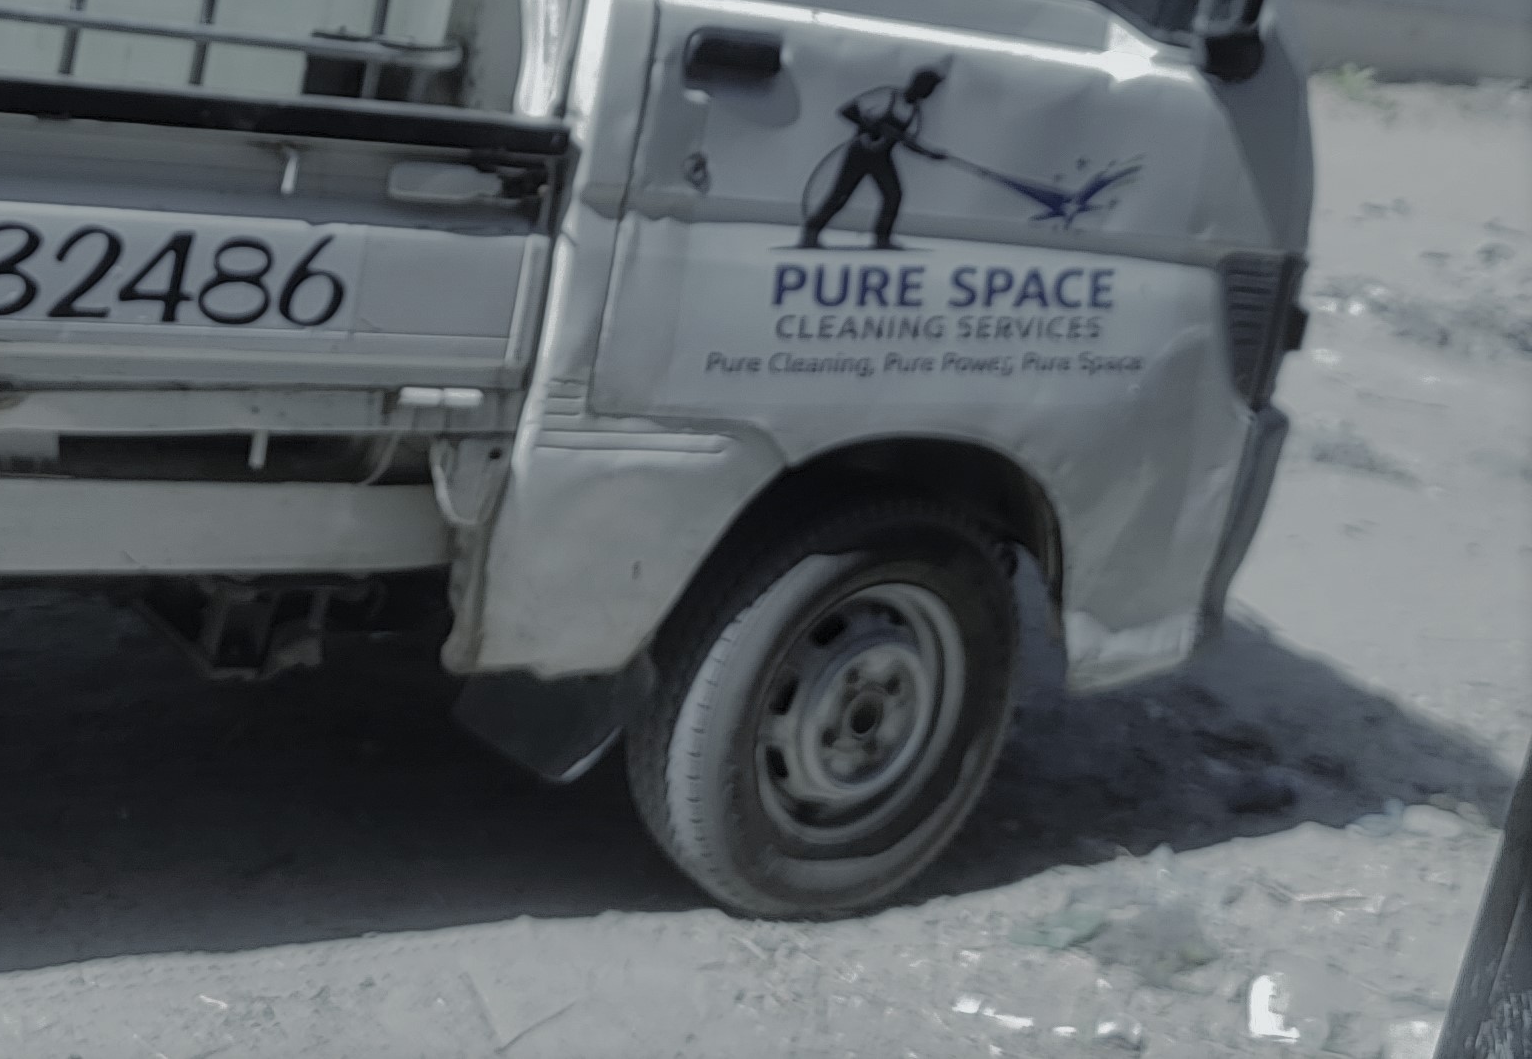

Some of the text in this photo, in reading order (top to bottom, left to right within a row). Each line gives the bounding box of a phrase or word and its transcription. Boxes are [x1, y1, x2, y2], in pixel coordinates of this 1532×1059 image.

[772, 263, 1115, 309] PURE SPACE
[775, 313, 1103, 342] CLEANING SERVICES
[704, 350, 763, 374] Pure
[768, 350, 875, 378] Cleaning,
[883, 350, 935, 373] Pure
[1021, 350, 1071, 373] Pure
[1078, 349, 1144, 376] Space
